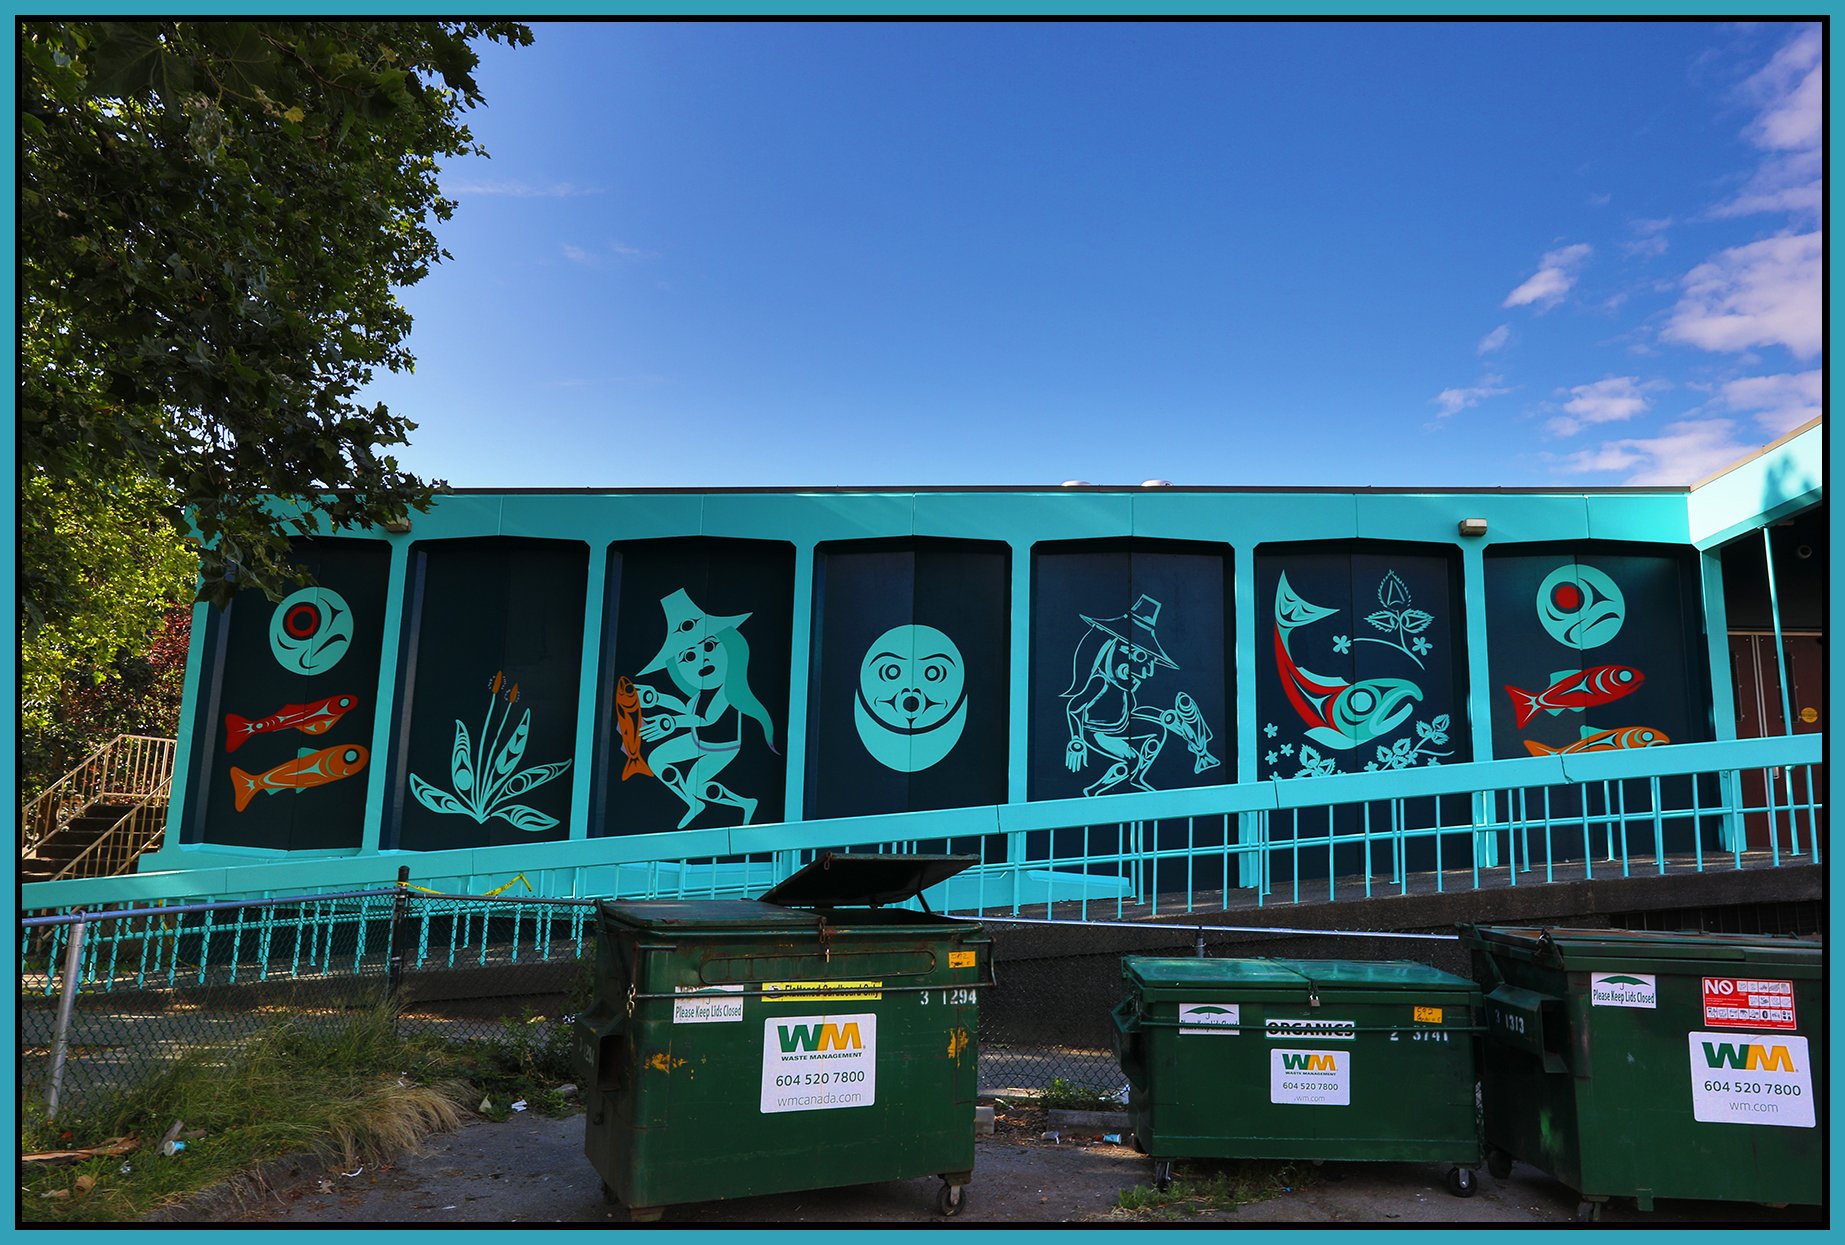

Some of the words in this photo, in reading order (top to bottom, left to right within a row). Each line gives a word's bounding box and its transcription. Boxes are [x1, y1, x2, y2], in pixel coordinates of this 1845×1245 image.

[1705, 980, 1734, 995] NO
[920, 990, 929, 1005] 3
[943, 989, 977, 1005] 1294
[1593, 989, 1610, 1001] Please
[1611, 991, 1625, 1005] Keep
[1625, 991, 1637, 1003] Lids
[1637, 992, 1655, 1004] Closed
[676, 1006, 695, 1018] Please
[696, 1005, 710, 1020] Keep
[711, 1005, 722, 1017] Lids
[723, 1004, 742, 1016] Closed
[1267, 1022, 1354, 1036] ORGANICS
[1505, 1014, 1525, 1034] 1313
[777, 1023, 862, 1053] WM
[809, 1052, 862, 1060] MANAGEMENT
[1282, 1054, 1337, 1071] WM
[1702, 1042, 1795, 1072] WM
[776, 1075, 801, 1087] 604
[804, 1073, 829, 1085] 520
[833, 1071, 865, 1084] 7800
[1283, 1082, 1299, 1090] 604
[1318, 1083, 1339, 1091] 7800
[1704, 1081, 1730, 1092] 604
[1735, 1082, 1761, 1094] 520
[1765, 1083, 1801, 1096] 7800
[777, 1092, 862, 1107] wmcanada.com
[1729, 1102, 1779, 1112] wm.com
